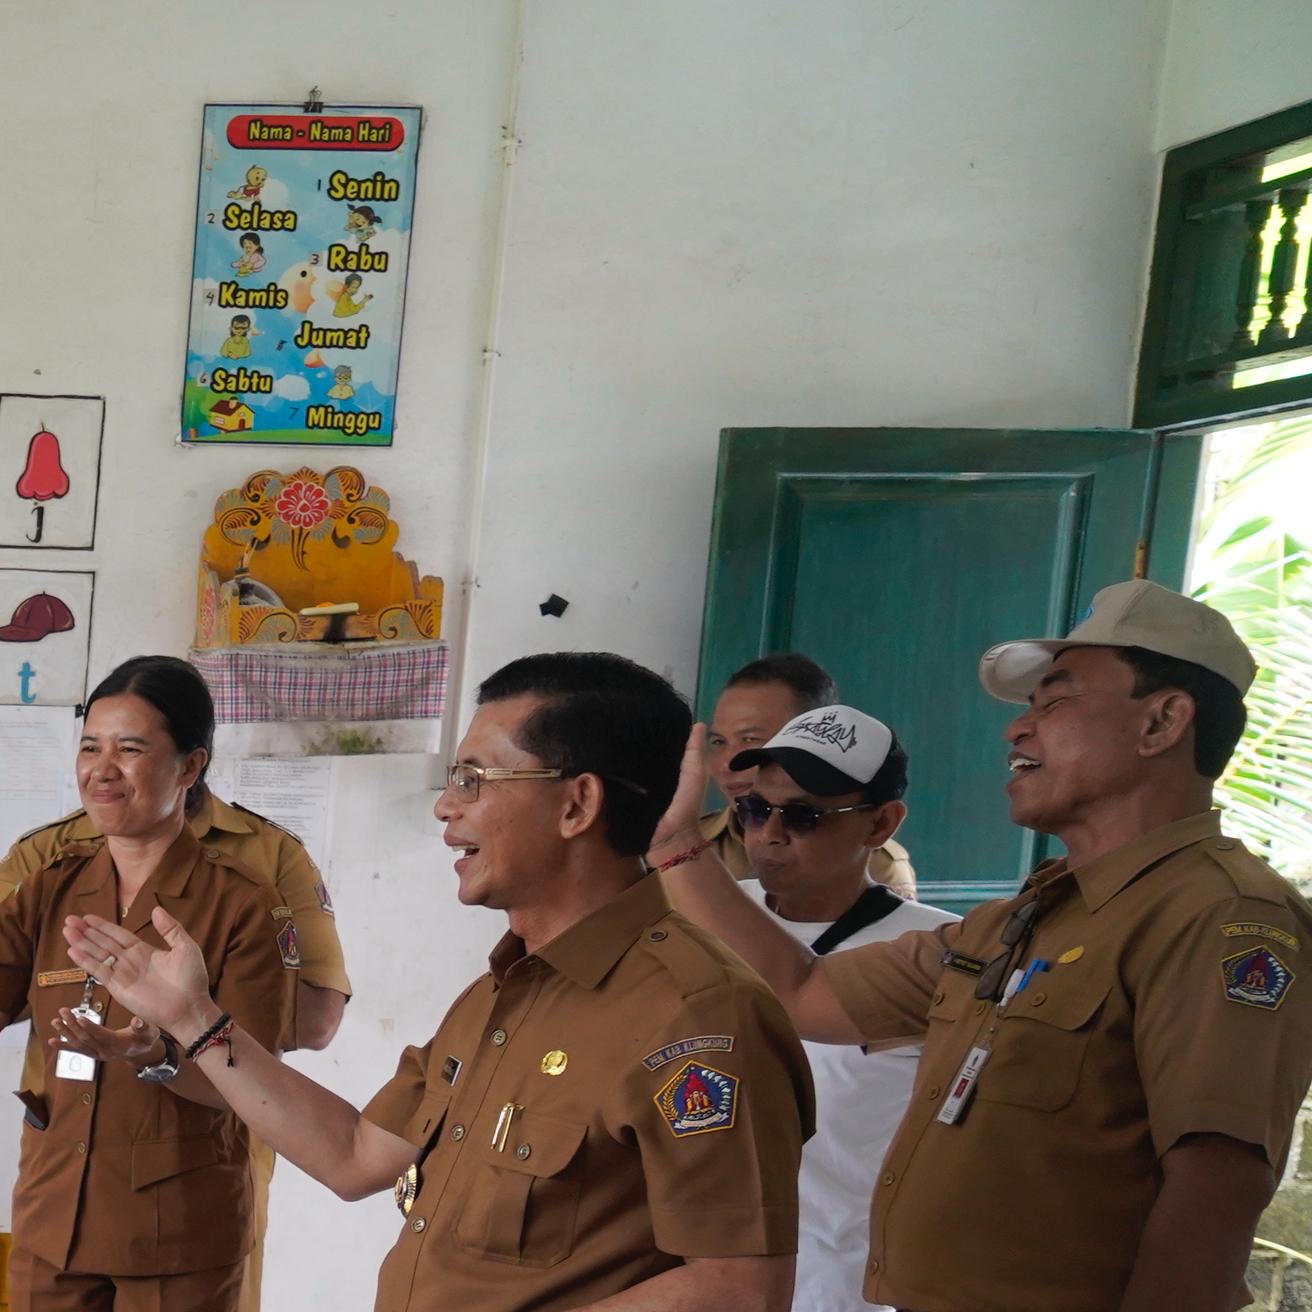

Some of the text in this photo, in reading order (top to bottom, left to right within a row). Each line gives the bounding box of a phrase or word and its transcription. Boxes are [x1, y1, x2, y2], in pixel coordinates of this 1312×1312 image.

[249, 120, 292, 141] Nama
[309, 122, 353, 143] Nama
[357, 123, 392, 144] Hari
[328, 170, 399, 201] Senin
[208, 202, 297, 231] 2 Selasa
[311, 245, 389, 273] 3 Rabu
[219, 283, 289, 309] Kamis
[295, 320, 370, 350] Jumat
[200, 369, 273, 394] 6 Sabtu
[307, 406, 382, 435] Minggu
[29, 502, 45, 543] j
[17, 661, 37, 704] t
